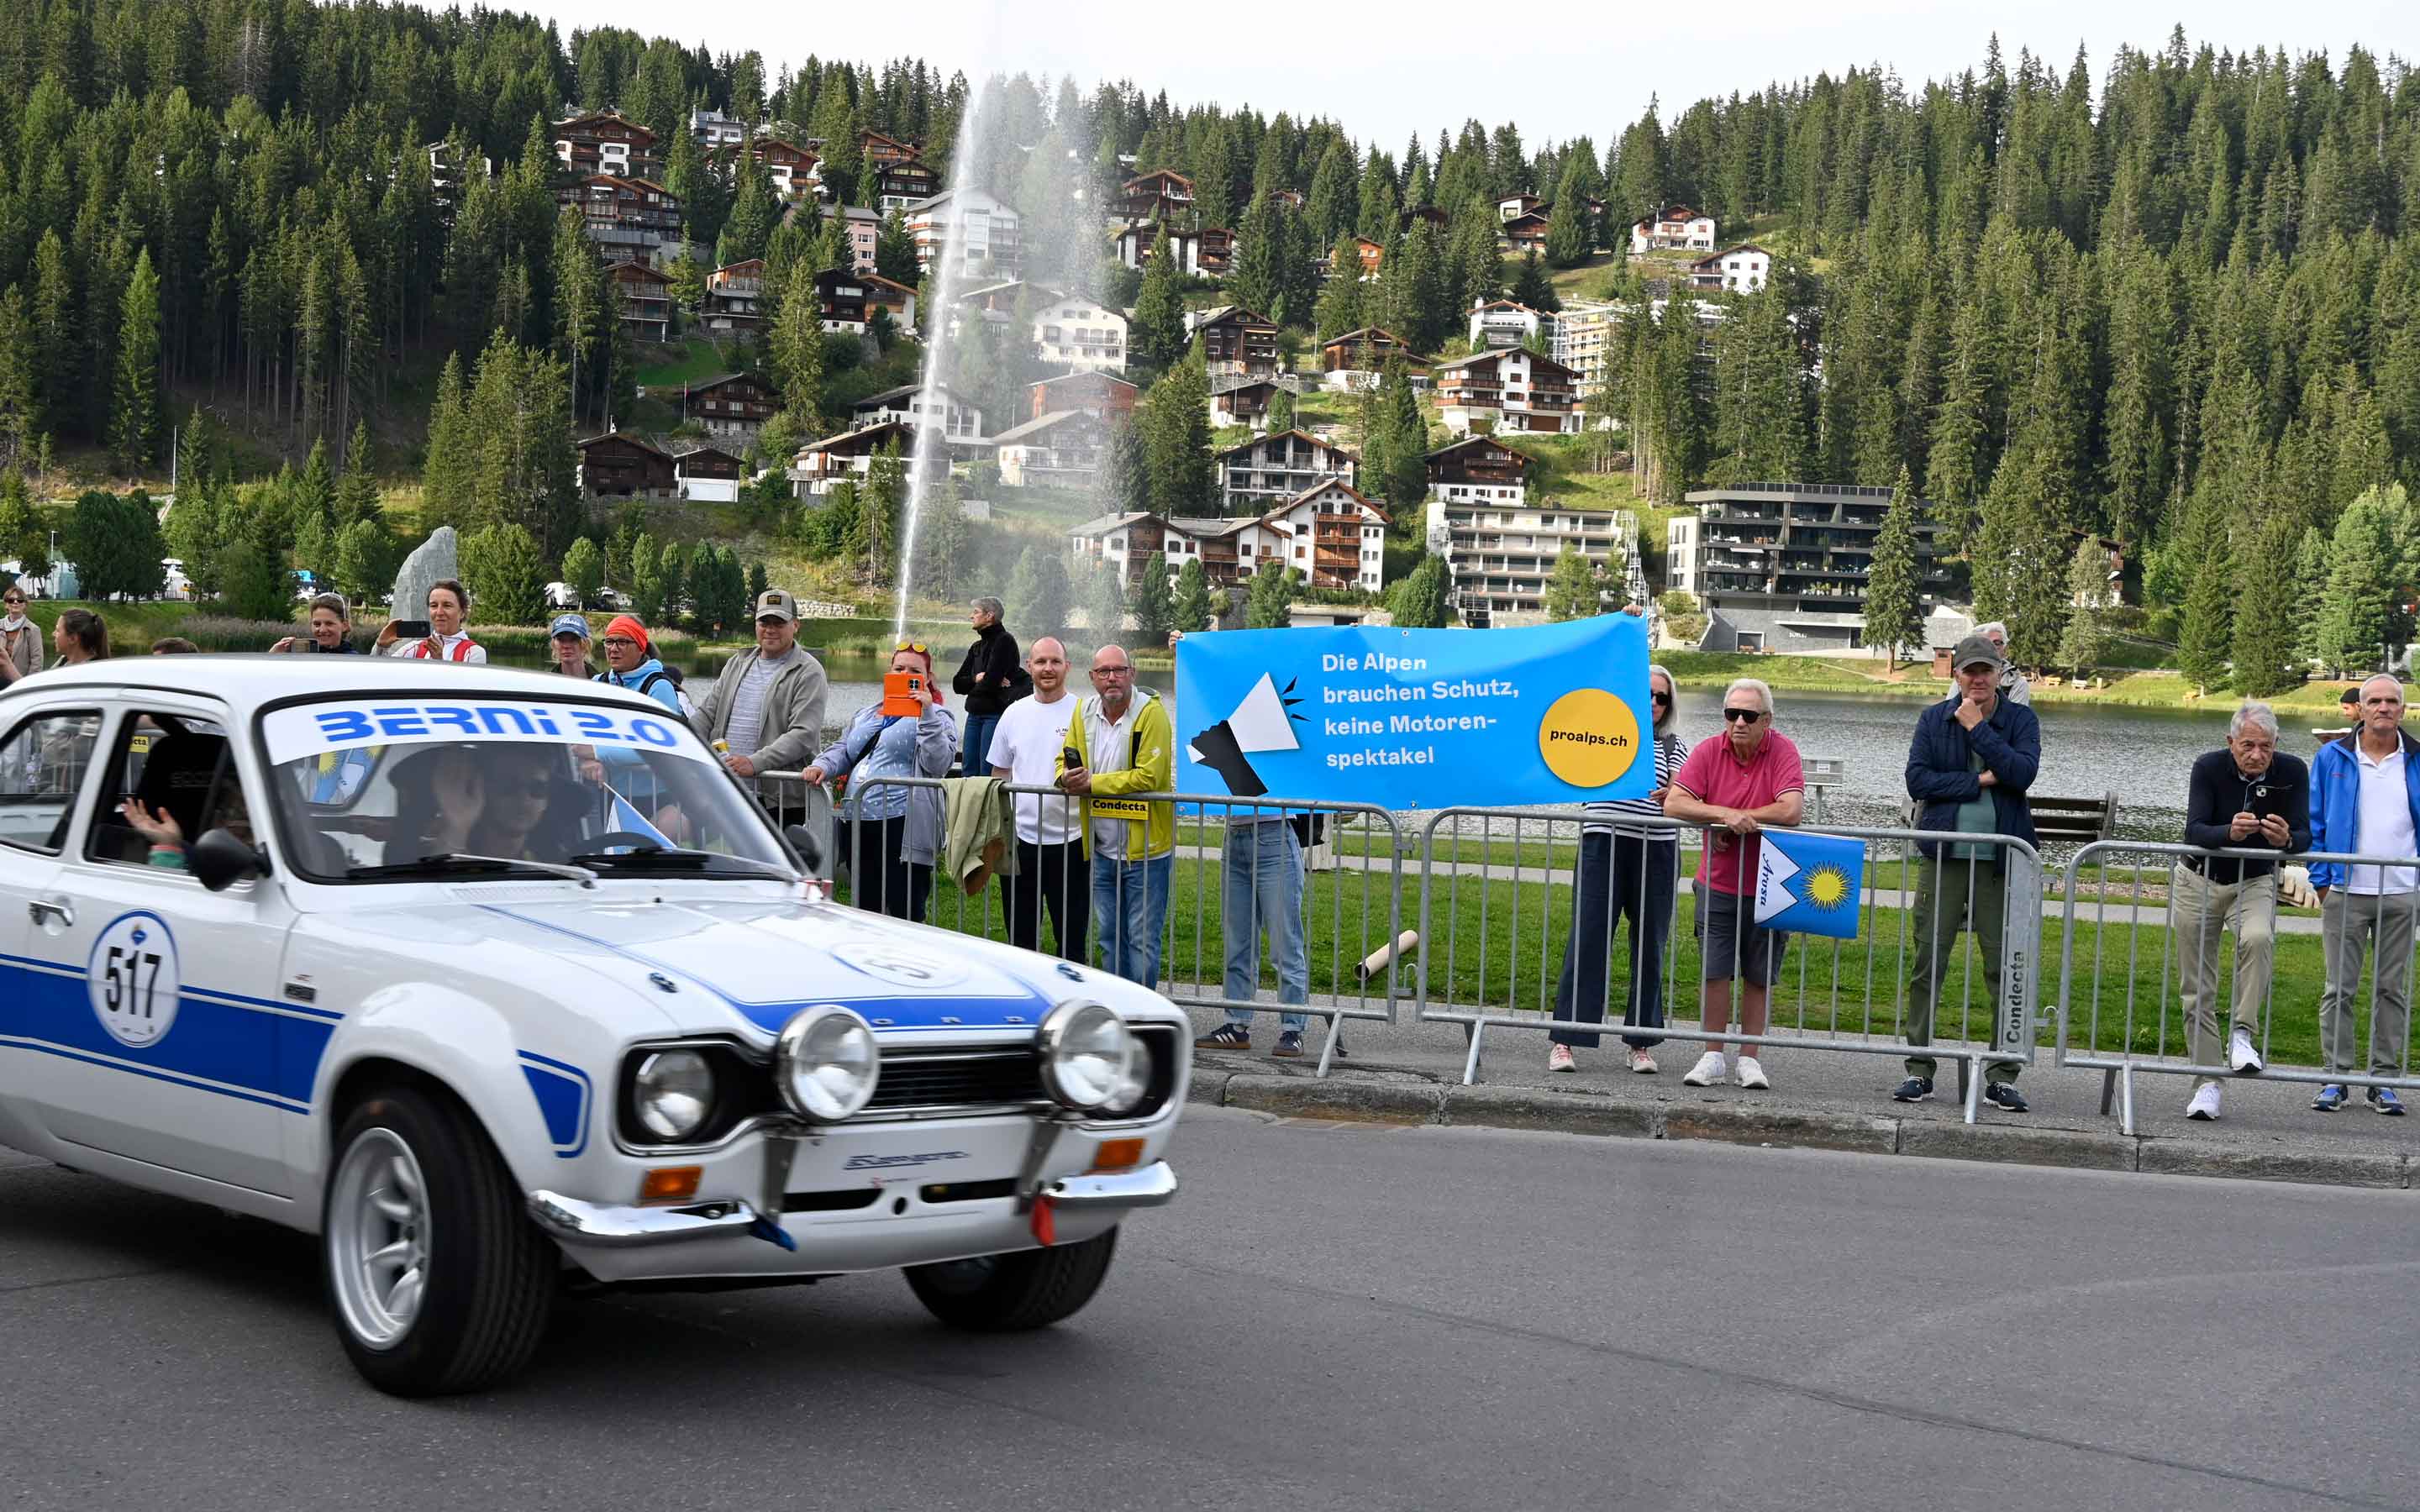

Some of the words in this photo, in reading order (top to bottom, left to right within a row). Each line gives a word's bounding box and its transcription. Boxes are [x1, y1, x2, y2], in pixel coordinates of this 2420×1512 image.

[1322, 654, 1359, 672] Die
[1363, 652, 1427, 673] Alpen
[1323, 684, 1426, 704] brauchen
[1431, 678, 1519, 699] Schutz,
[569, 711, 678, 748] 2.0
[1324, 717, 1385, 736] keine
[1390, 714, 1497, 733] Motoren-
[1550, 729, 1628, 747] proalps.ch
[1326, 745, 1434, 770] spektakel
[1092, 799, 1146, 811] Condecta
[1759, 852, 1775, 907] Arosa
[106, 946, 162, 1019] 517
[2006, 951, 2025, 1044] Condecta
